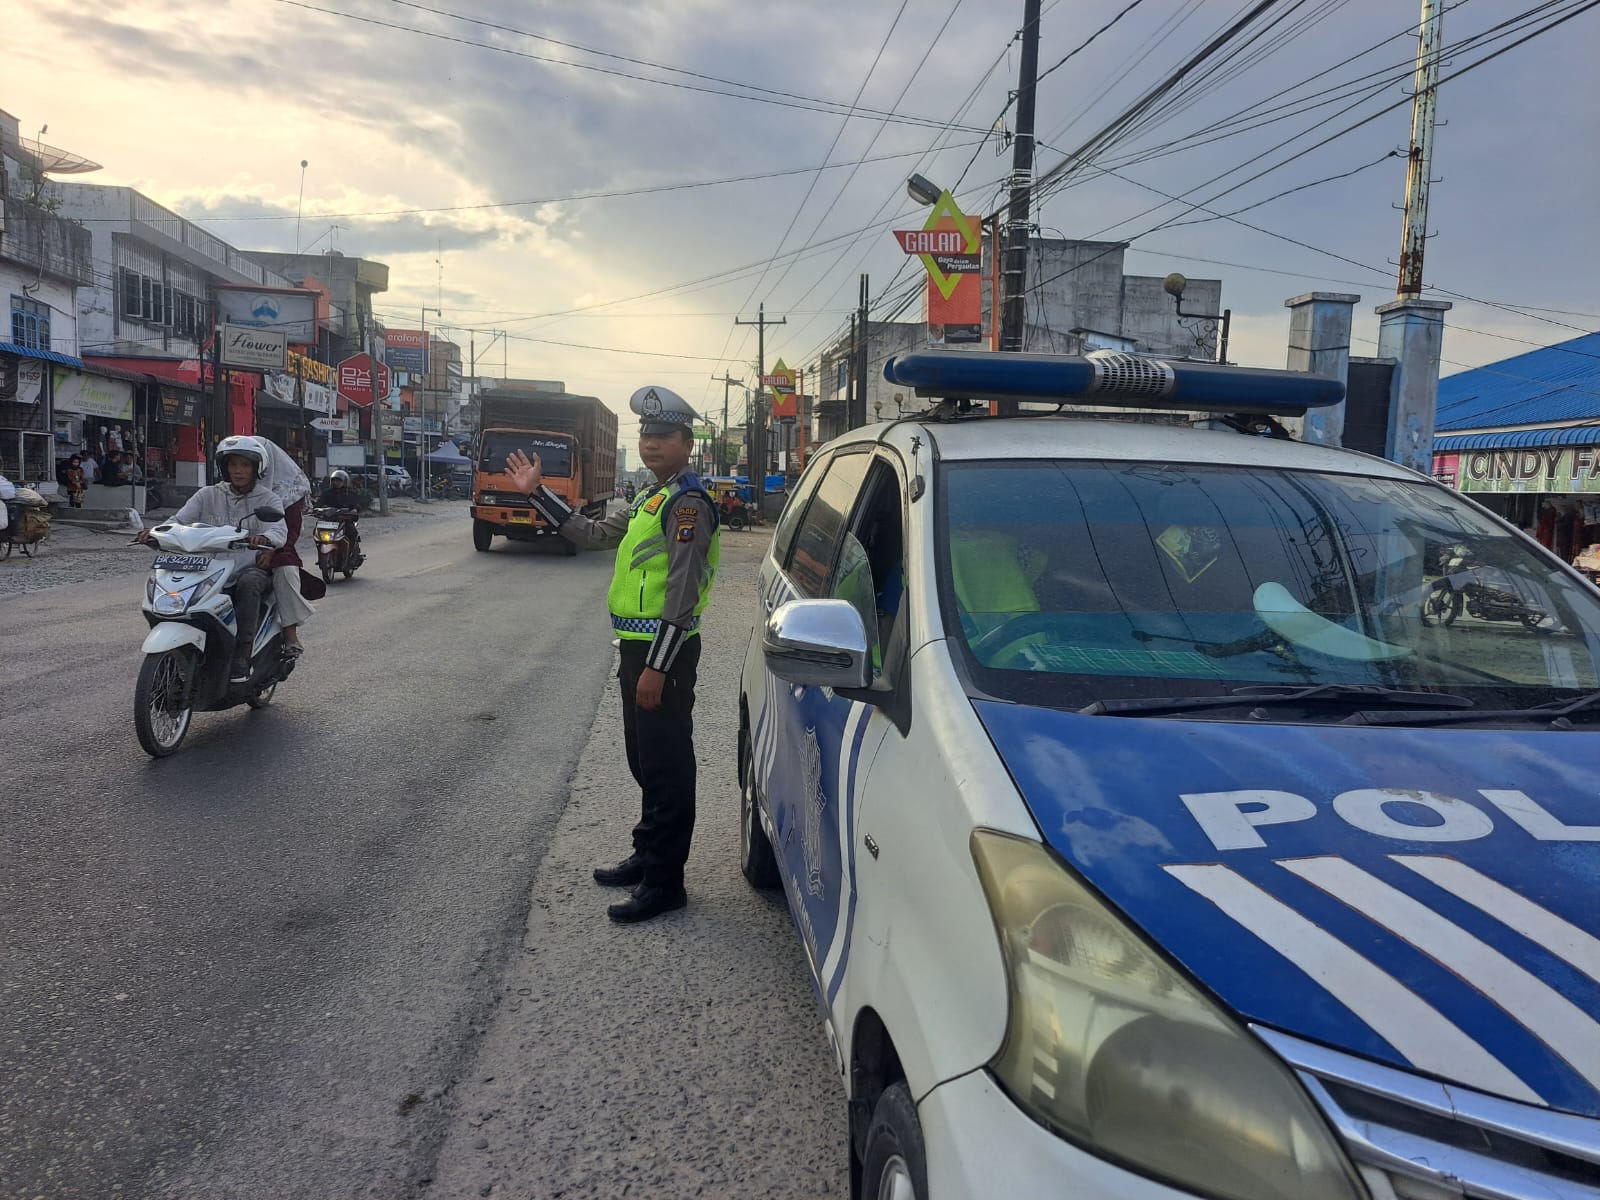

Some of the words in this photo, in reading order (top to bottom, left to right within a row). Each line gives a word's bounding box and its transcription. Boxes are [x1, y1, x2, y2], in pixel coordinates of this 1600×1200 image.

[905, 232, 961, 252] GALAN
[229, 332, 282, 352] Flower
[1468, 448, 1565, 481] CINDY
[1179, 789, 1600, 851] POL
